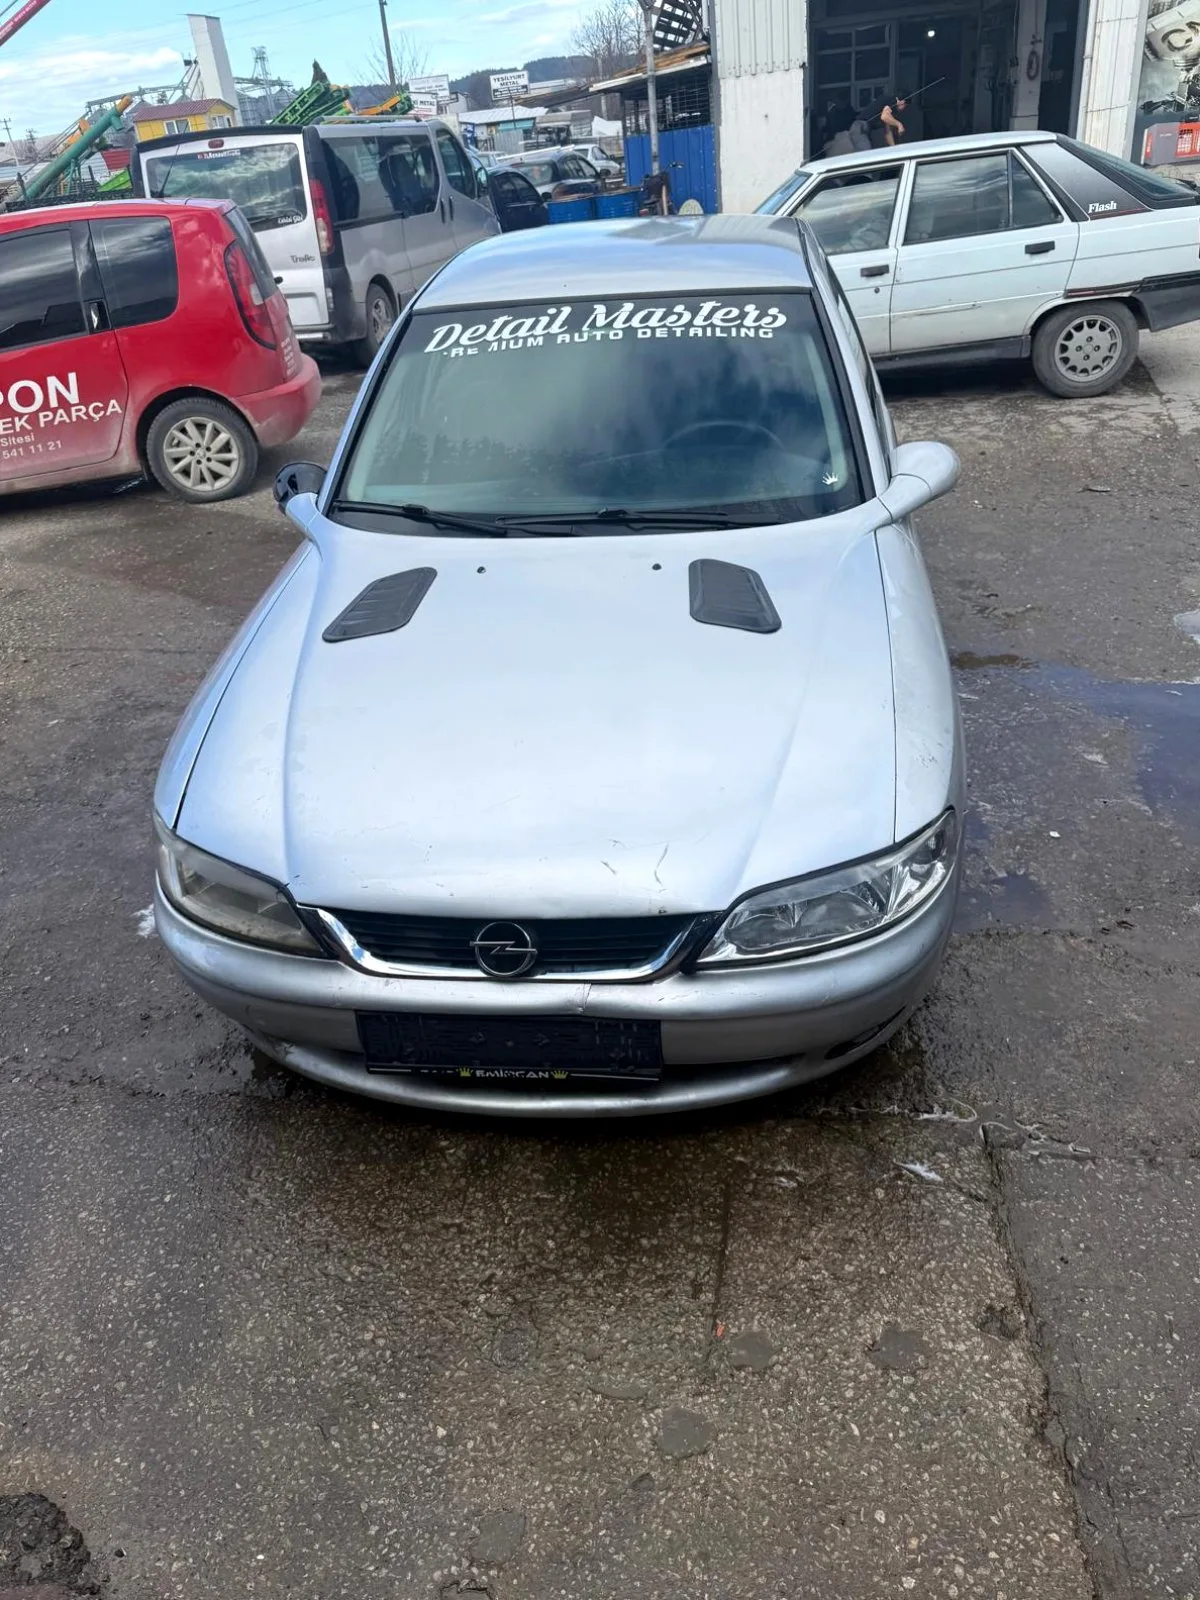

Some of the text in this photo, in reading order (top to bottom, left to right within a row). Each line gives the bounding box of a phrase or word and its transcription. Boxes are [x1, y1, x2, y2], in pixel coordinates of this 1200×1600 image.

[1088, 201, 1117, 214] Flash
[424, 301, 787, 353] Detail Masters
[557, 329, 623, 344] AUTO
[637, 327, 773, 339] DETAILING
[38, 399, 122, 428] PARÇA
[0, 432, 35, 447] Sitesi
[2, 440, 62, 459] 541 11 21
